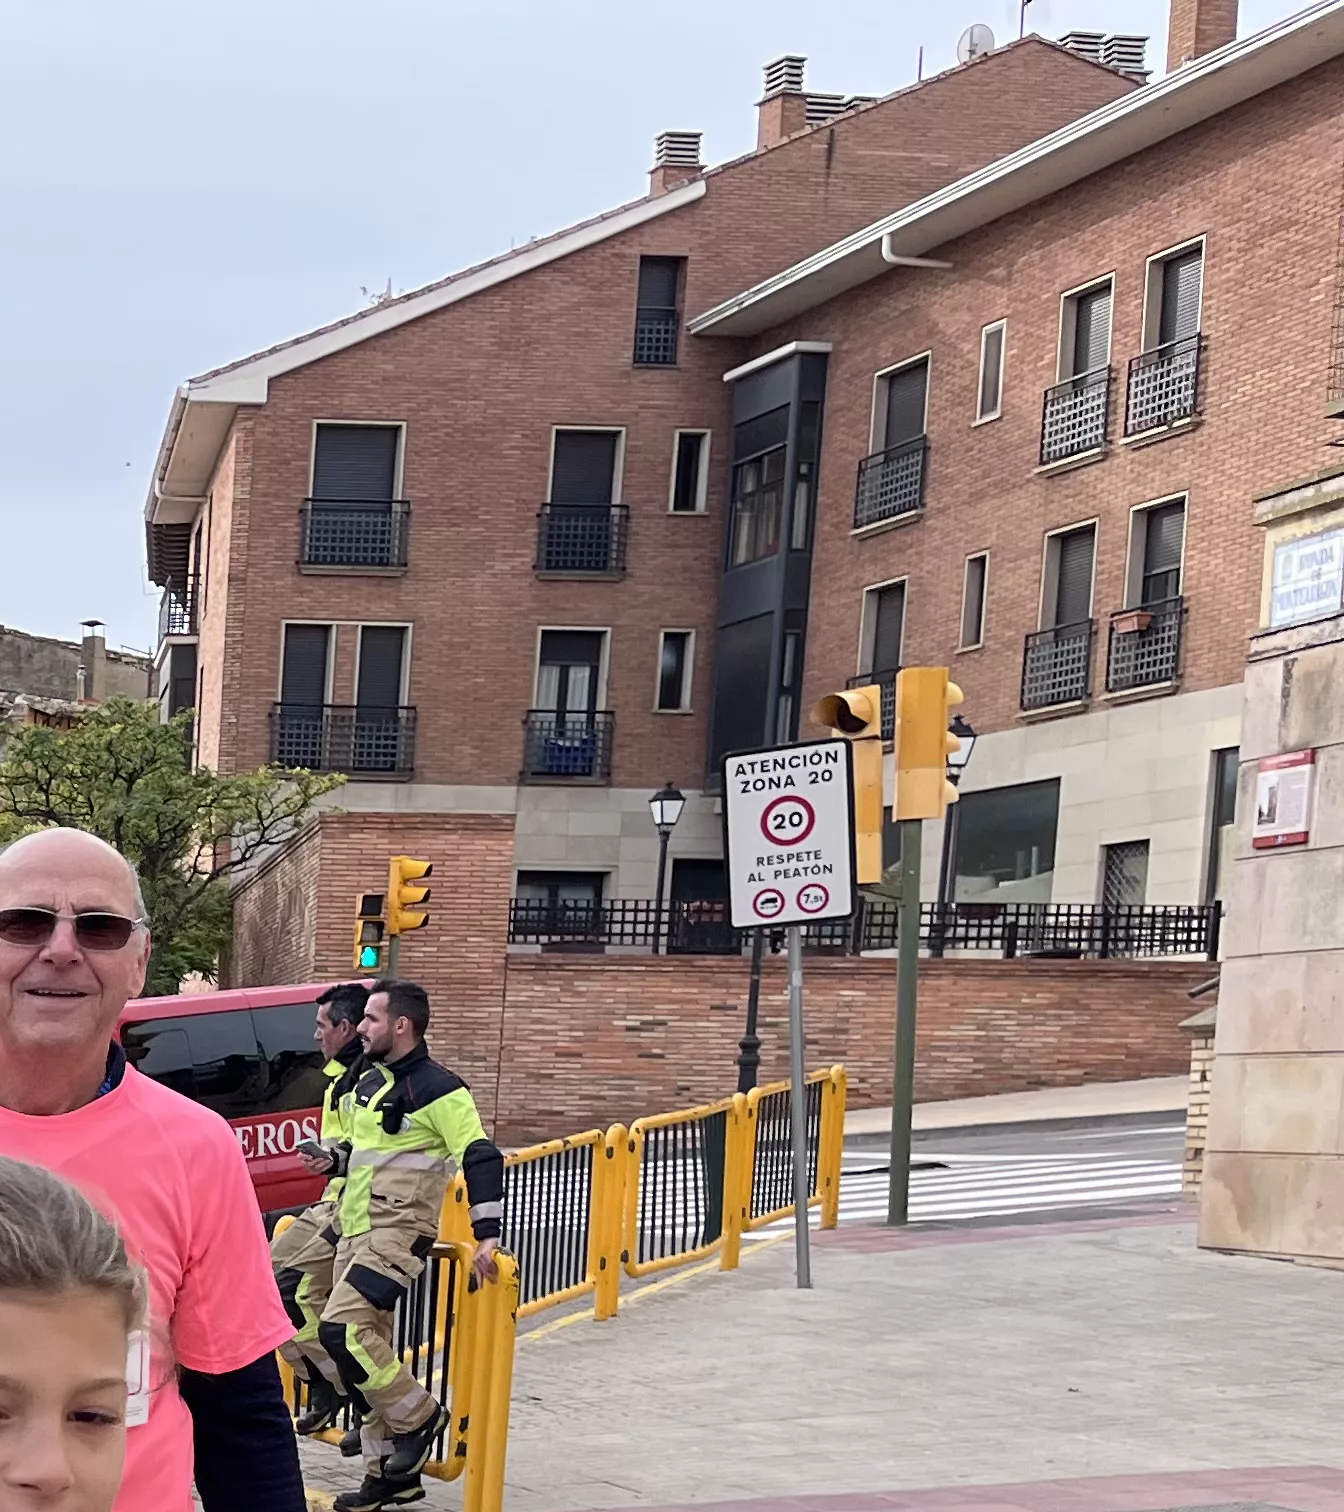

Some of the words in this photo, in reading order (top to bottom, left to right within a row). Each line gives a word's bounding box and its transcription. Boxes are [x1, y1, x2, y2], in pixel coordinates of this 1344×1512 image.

[735, 750, 838, 777] ATENCIÓN
[740, 774, 796, 794] ZONA
[808, 769, 833, 785] 20
[773, 811, 803, 830] 20
[756, 849, 823, 867] RESPETE
[747, 873, 765, 883] AL
[774, 863, 833, 880] PEATÓN
